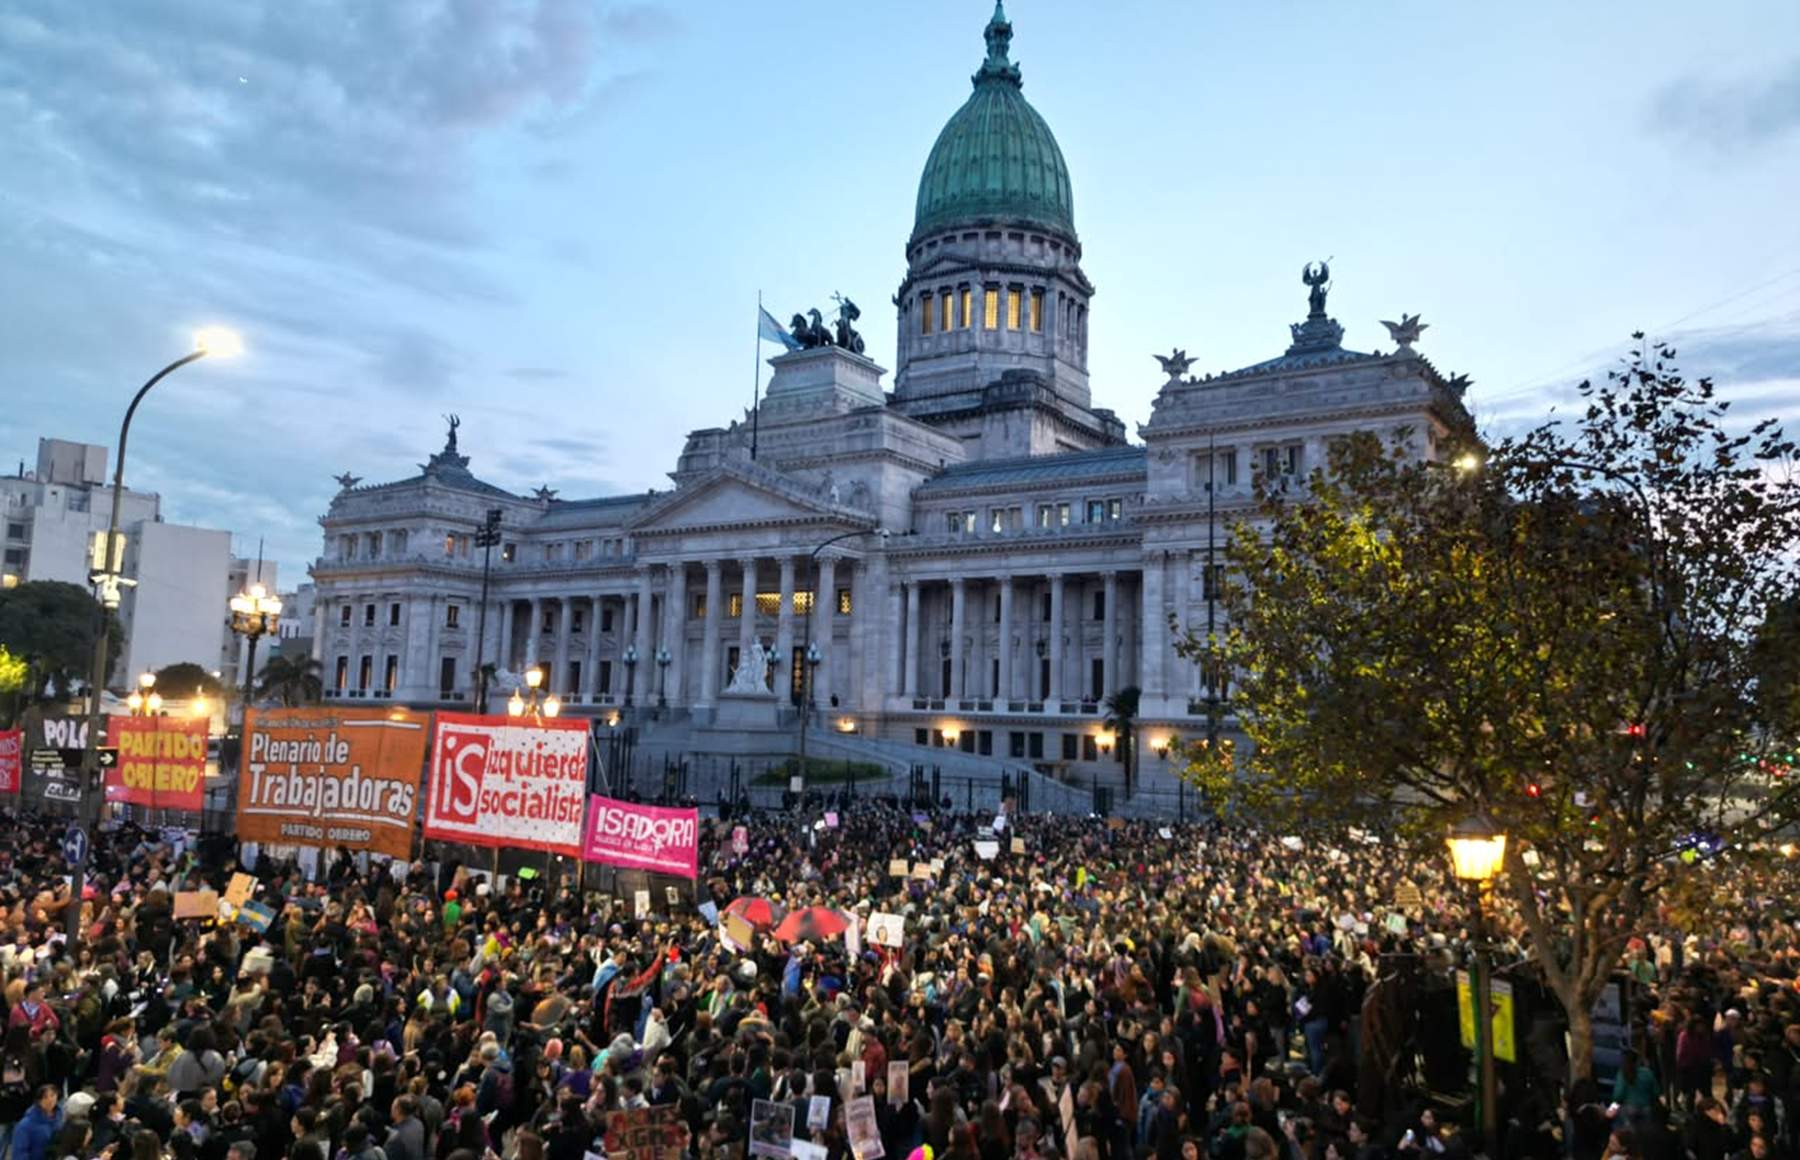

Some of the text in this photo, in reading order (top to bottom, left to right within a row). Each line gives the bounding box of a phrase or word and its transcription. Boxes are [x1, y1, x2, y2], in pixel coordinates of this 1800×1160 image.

[250, 732, 349, 764] Plenario de
[249, 763, 414, 818] Trabajadoras
[281, 823, 371, 842] PARTIDO OBRERO
[597, 806, 694, 852] ISADORA
